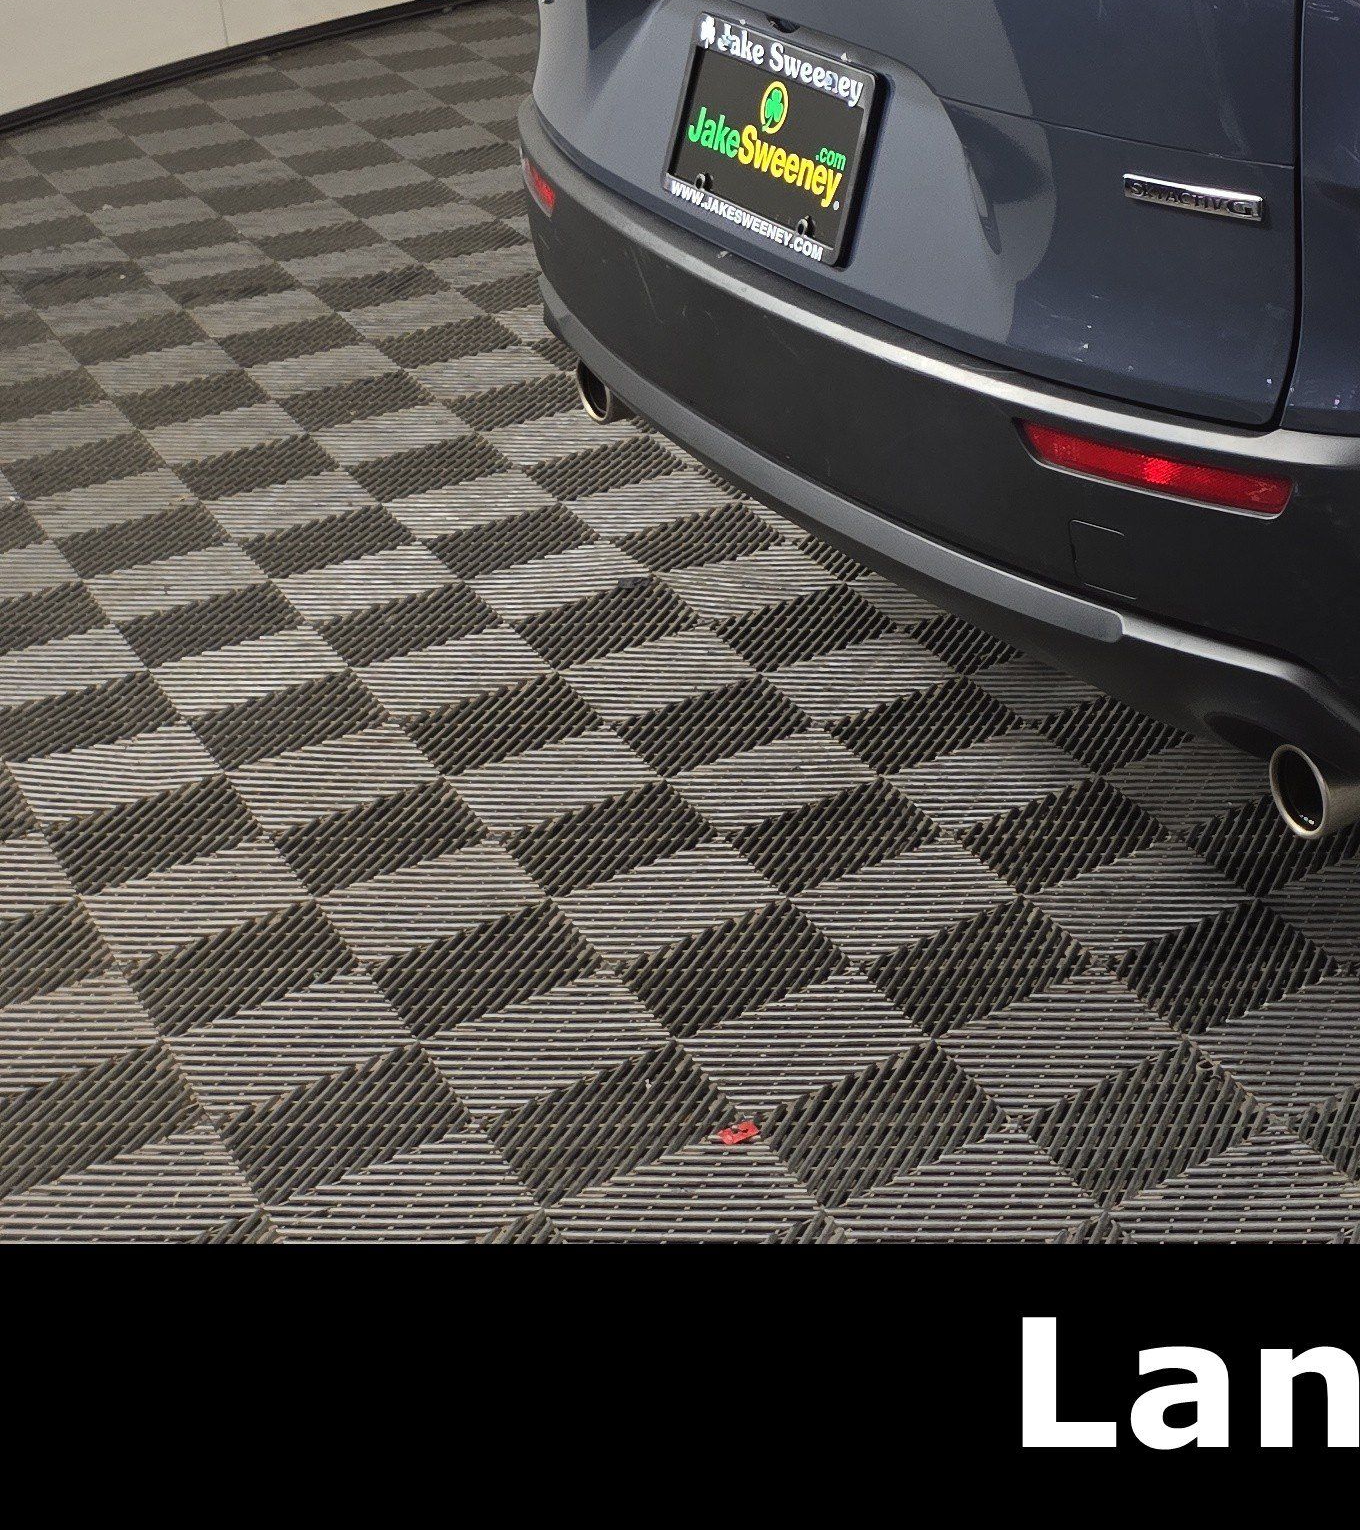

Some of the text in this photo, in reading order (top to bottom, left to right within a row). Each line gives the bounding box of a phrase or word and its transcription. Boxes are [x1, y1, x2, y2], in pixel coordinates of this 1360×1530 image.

[718, 23, 864, 108] Jake Sweeney
[671, 179, 825, 263] WWW.JAKESWEENEY.COM
